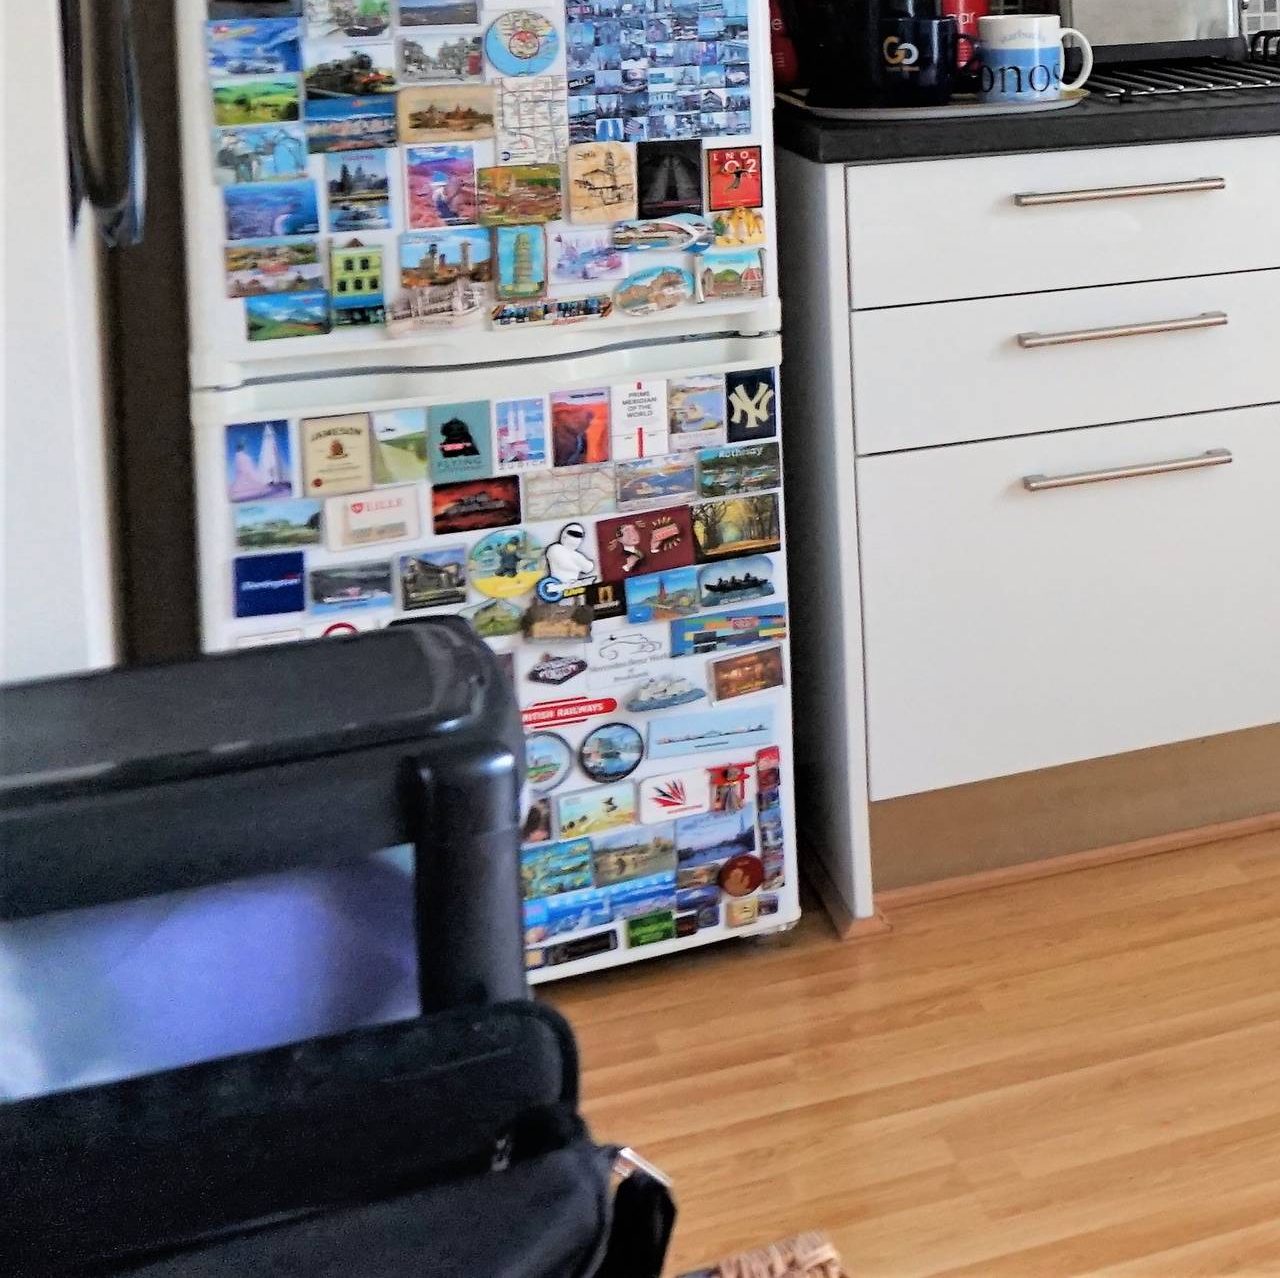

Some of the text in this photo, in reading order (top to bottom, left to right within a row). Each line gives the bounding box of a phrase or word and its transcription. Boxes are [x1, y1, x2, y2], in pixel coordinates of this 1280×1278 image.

[628, 390, 650, 398] PRIME
[622, 396, 658, 406] MERIDIAN
[626, 410, 653, 418] WORLD
[522, 703, 604, 722] RITISH RAILWAYS
